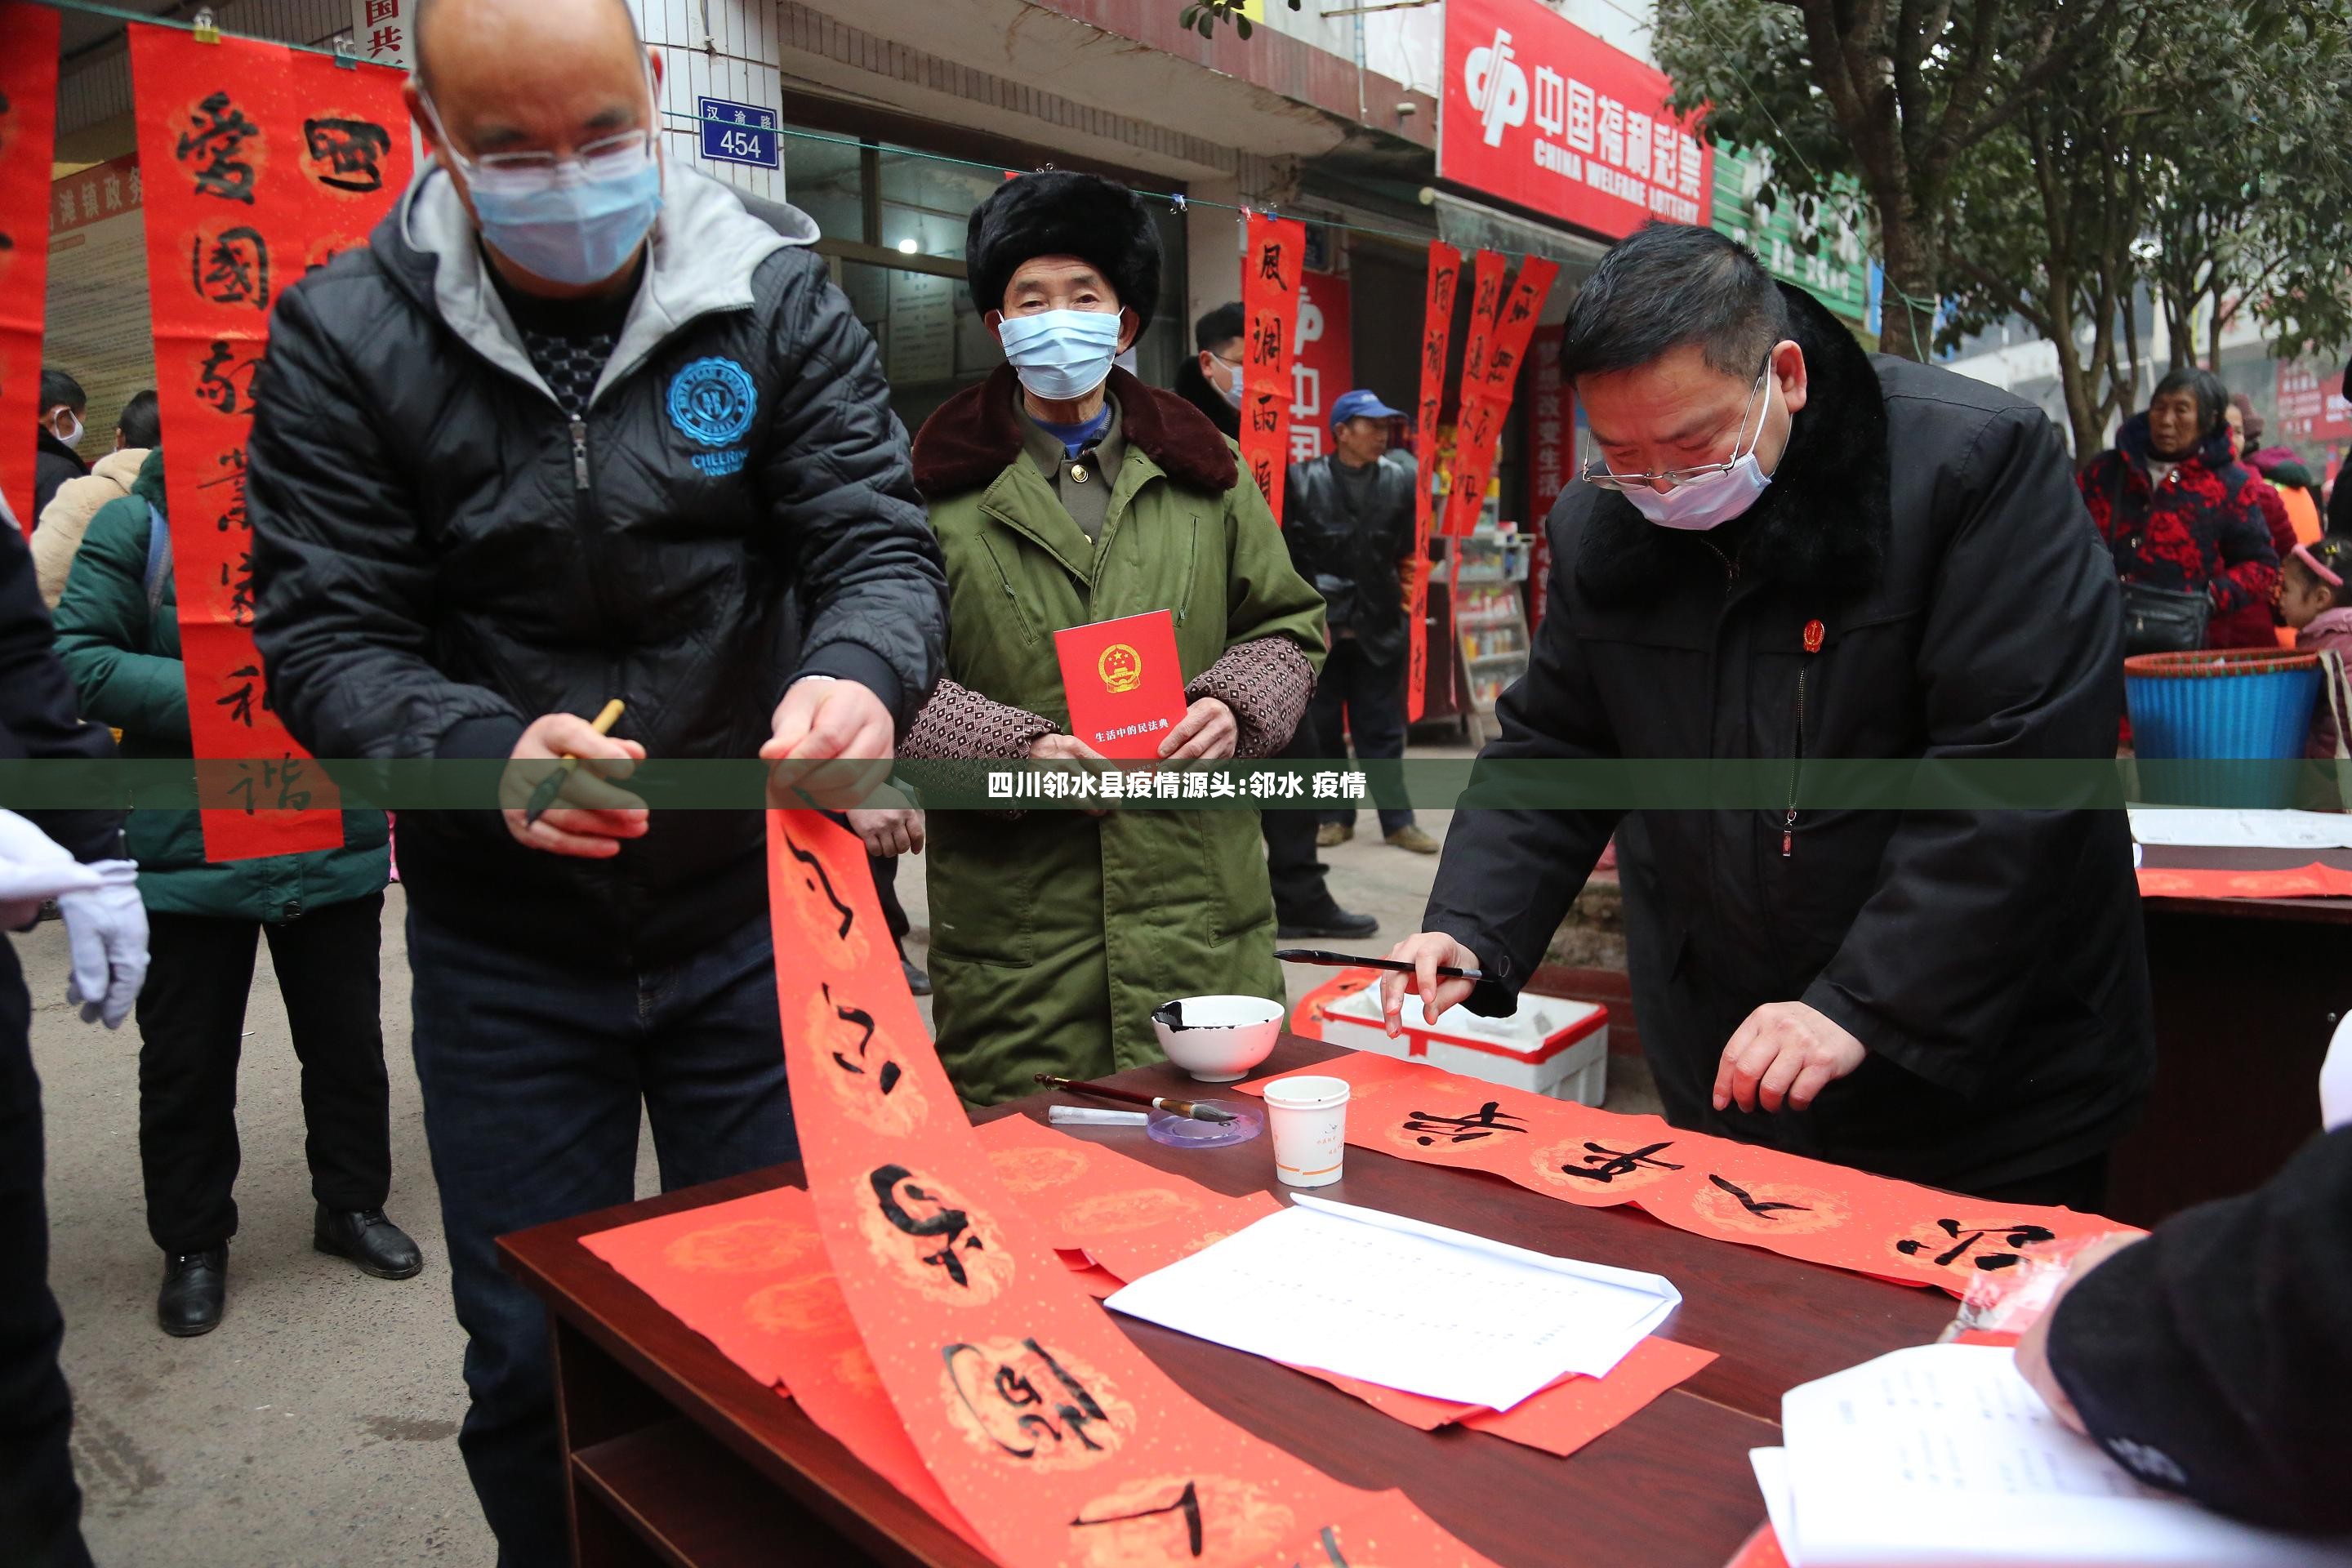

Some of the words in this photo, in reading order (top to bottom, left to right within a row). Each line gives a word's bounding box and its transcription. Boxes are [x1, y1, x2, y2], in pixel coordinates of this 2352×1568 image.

[366, 0, 403, 64] 国共
[706, 105, 772, 129] 汉渝路
[1535, 65, 1703, 199] 中国福利彩票
[720, 130, 761, 158] 454
[1534, 137, 1583, 182] CHINA
[1585, 158, 1646, 207] WELFARE
[1648, 186, 1699, 225] LOTTERY
[1095, 718, 1169, 743] 生活中的民法典
